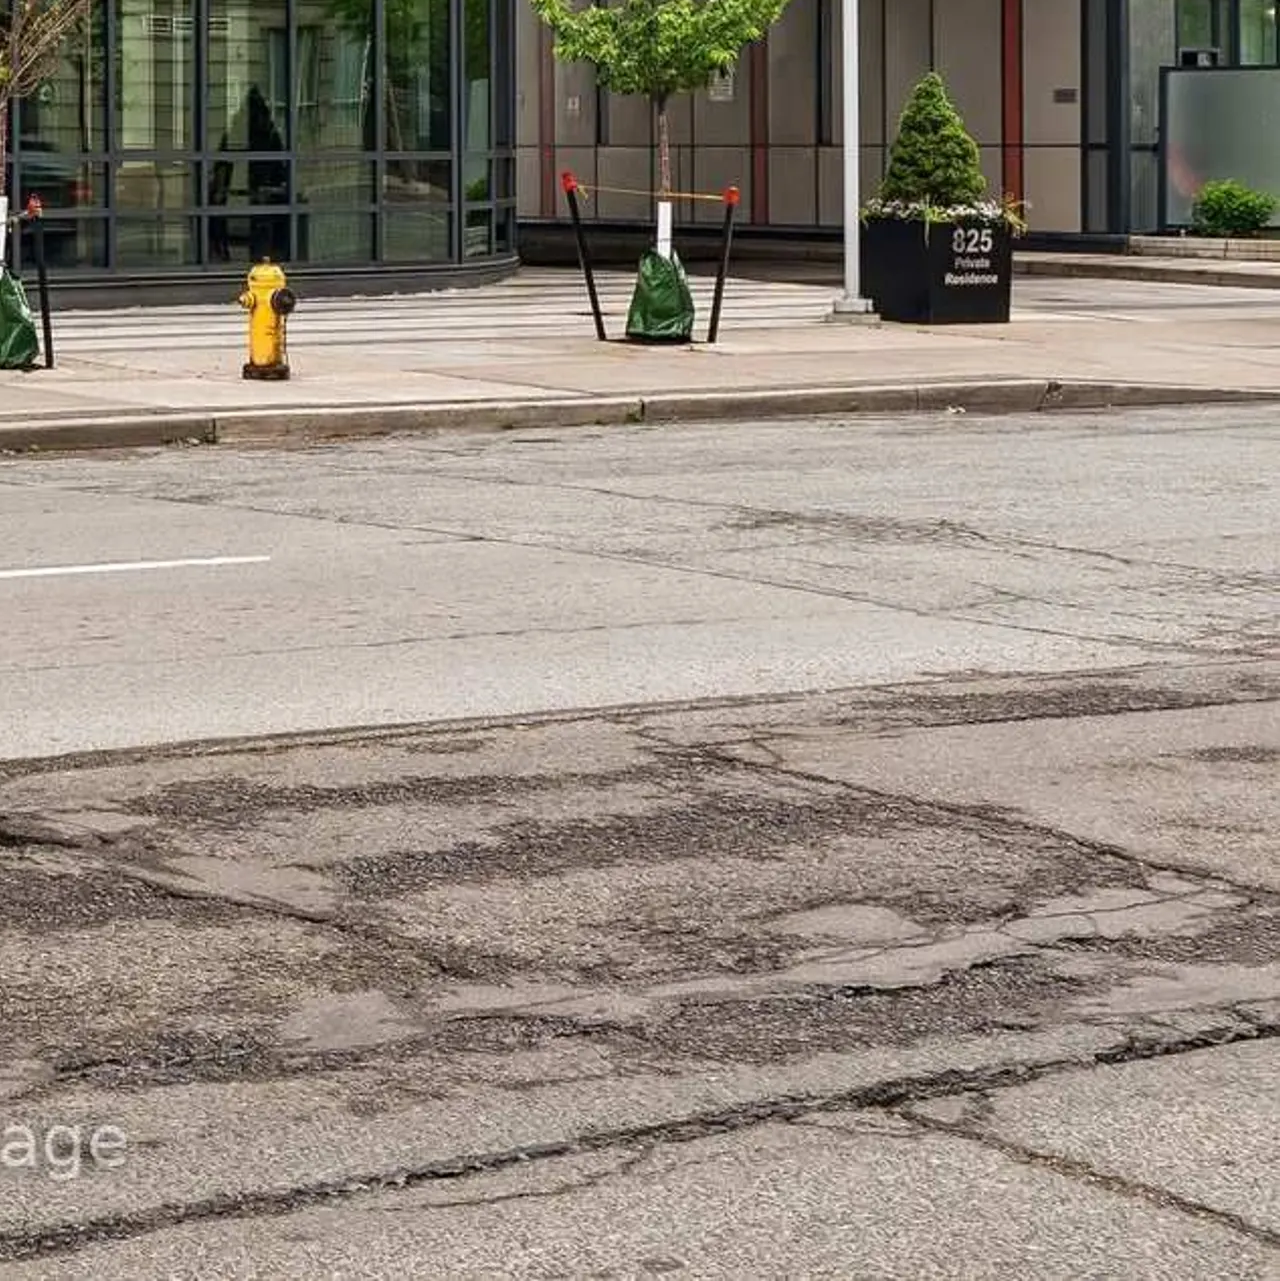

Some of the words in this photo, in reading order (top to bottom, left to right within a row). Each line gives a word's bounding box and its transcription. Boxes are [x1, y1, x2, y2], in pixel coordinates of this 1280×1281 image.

[952, 228, 993, 253] 825
[954, 257, 990, 269] Private
[944, 272, 999, 286] Residence
